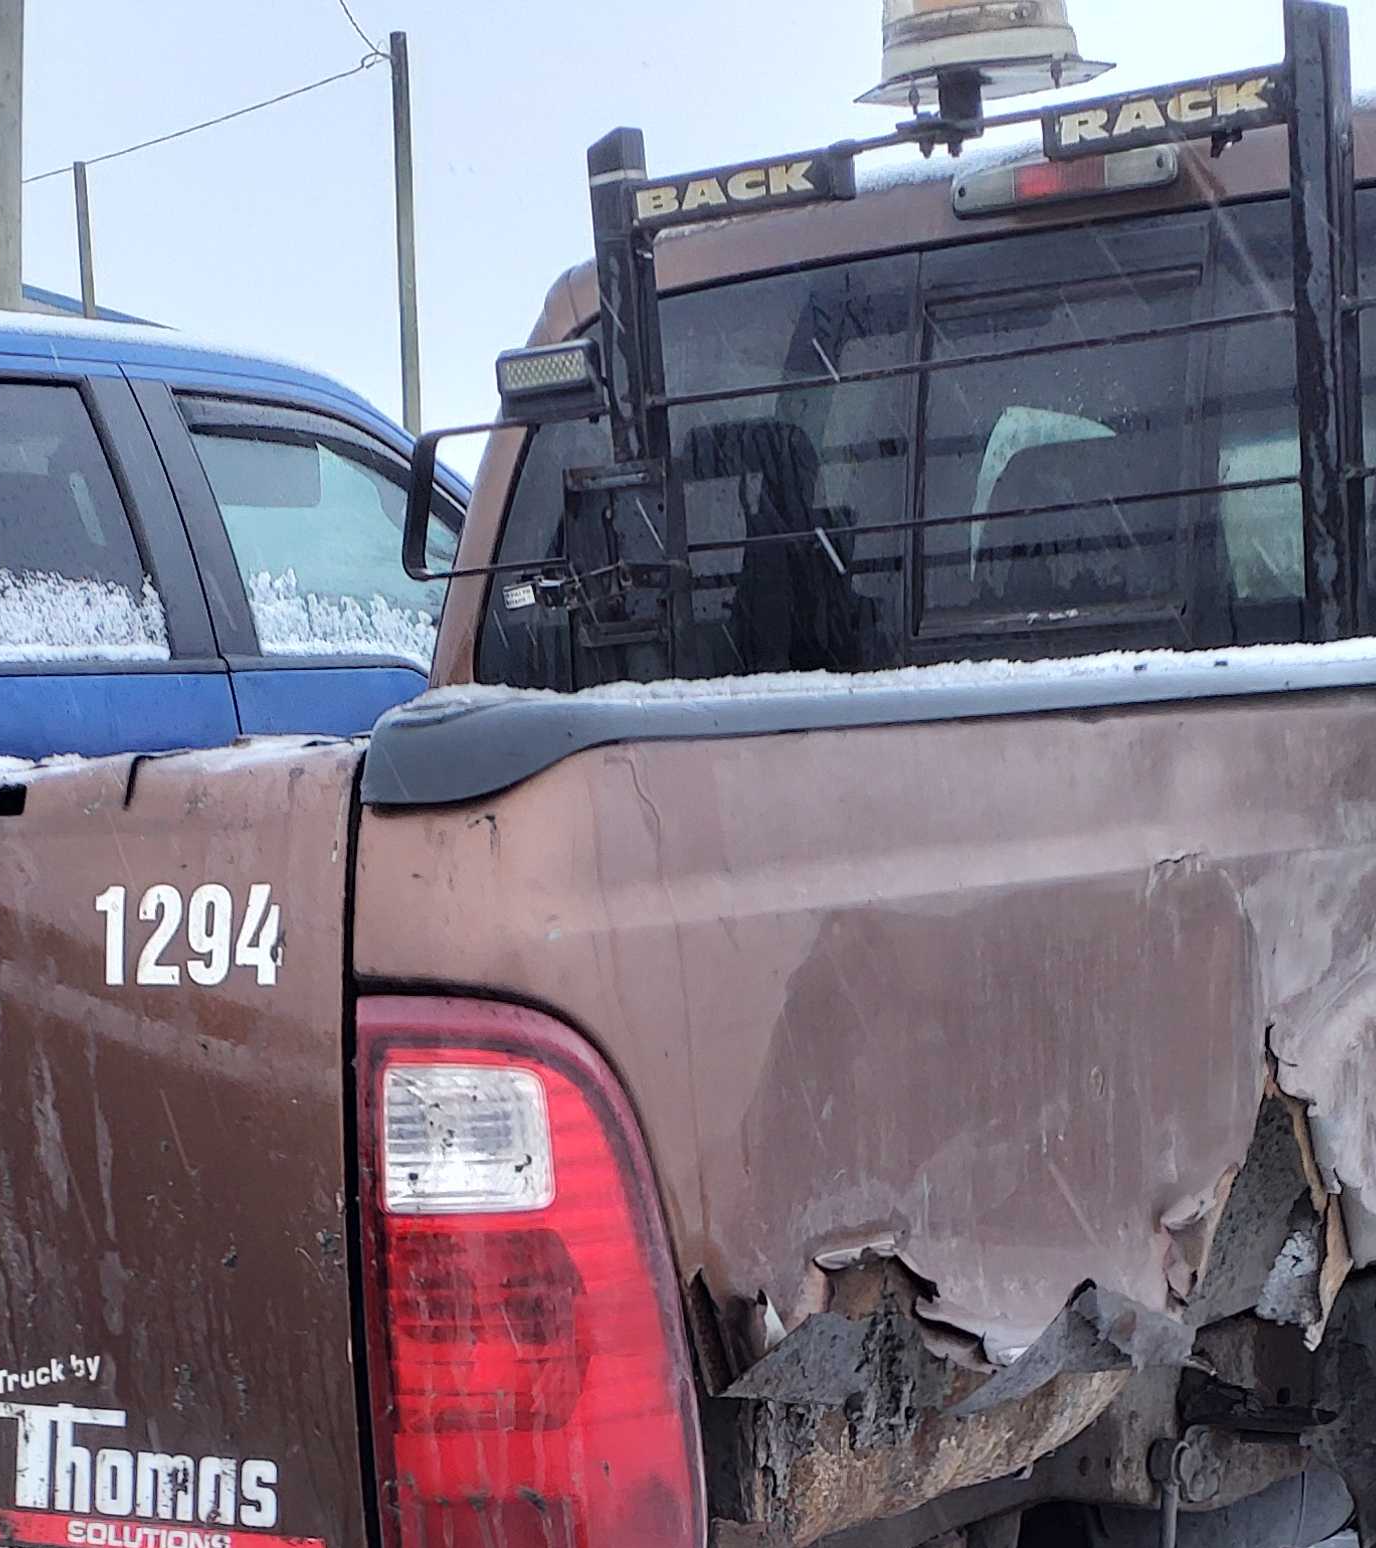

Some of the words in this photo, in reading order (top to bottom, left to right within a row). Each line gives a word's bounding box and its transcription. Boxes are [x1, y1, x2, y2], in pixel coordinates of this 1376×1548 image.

[636, 161, 814, 219] BACK
[1059, 76, 1270, 146] RACK
[95, 883, 283, 986] 1294
[70, 1354, 101, 1381] by
